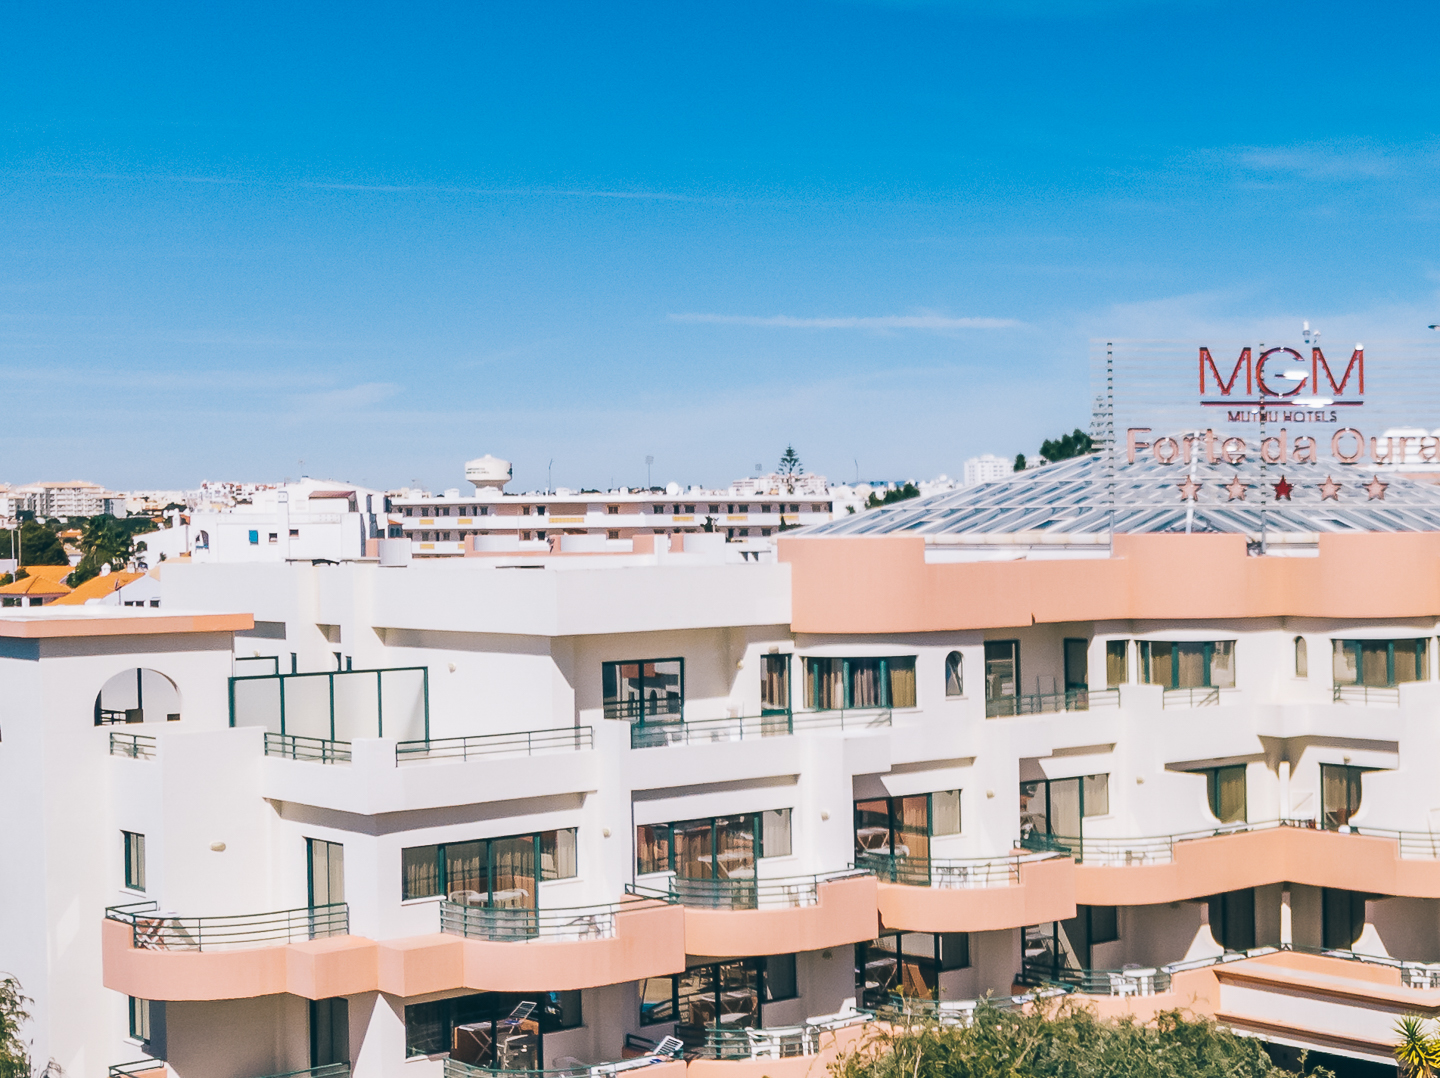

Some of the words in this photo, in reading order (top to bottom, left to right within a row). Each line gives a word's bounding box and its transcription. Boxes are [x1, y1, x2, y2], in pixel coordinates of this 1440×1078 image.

[1199, 346, 1364, 398] MGM
[1227, 410, 1278, 422] MUTHU
[1283, 410, 1337, 422] HOTELS
[1126, 428, 1246, 465] Forte
[1260, 428, 1317, 465] da
[1331, 427, 1440, 465] Oura
